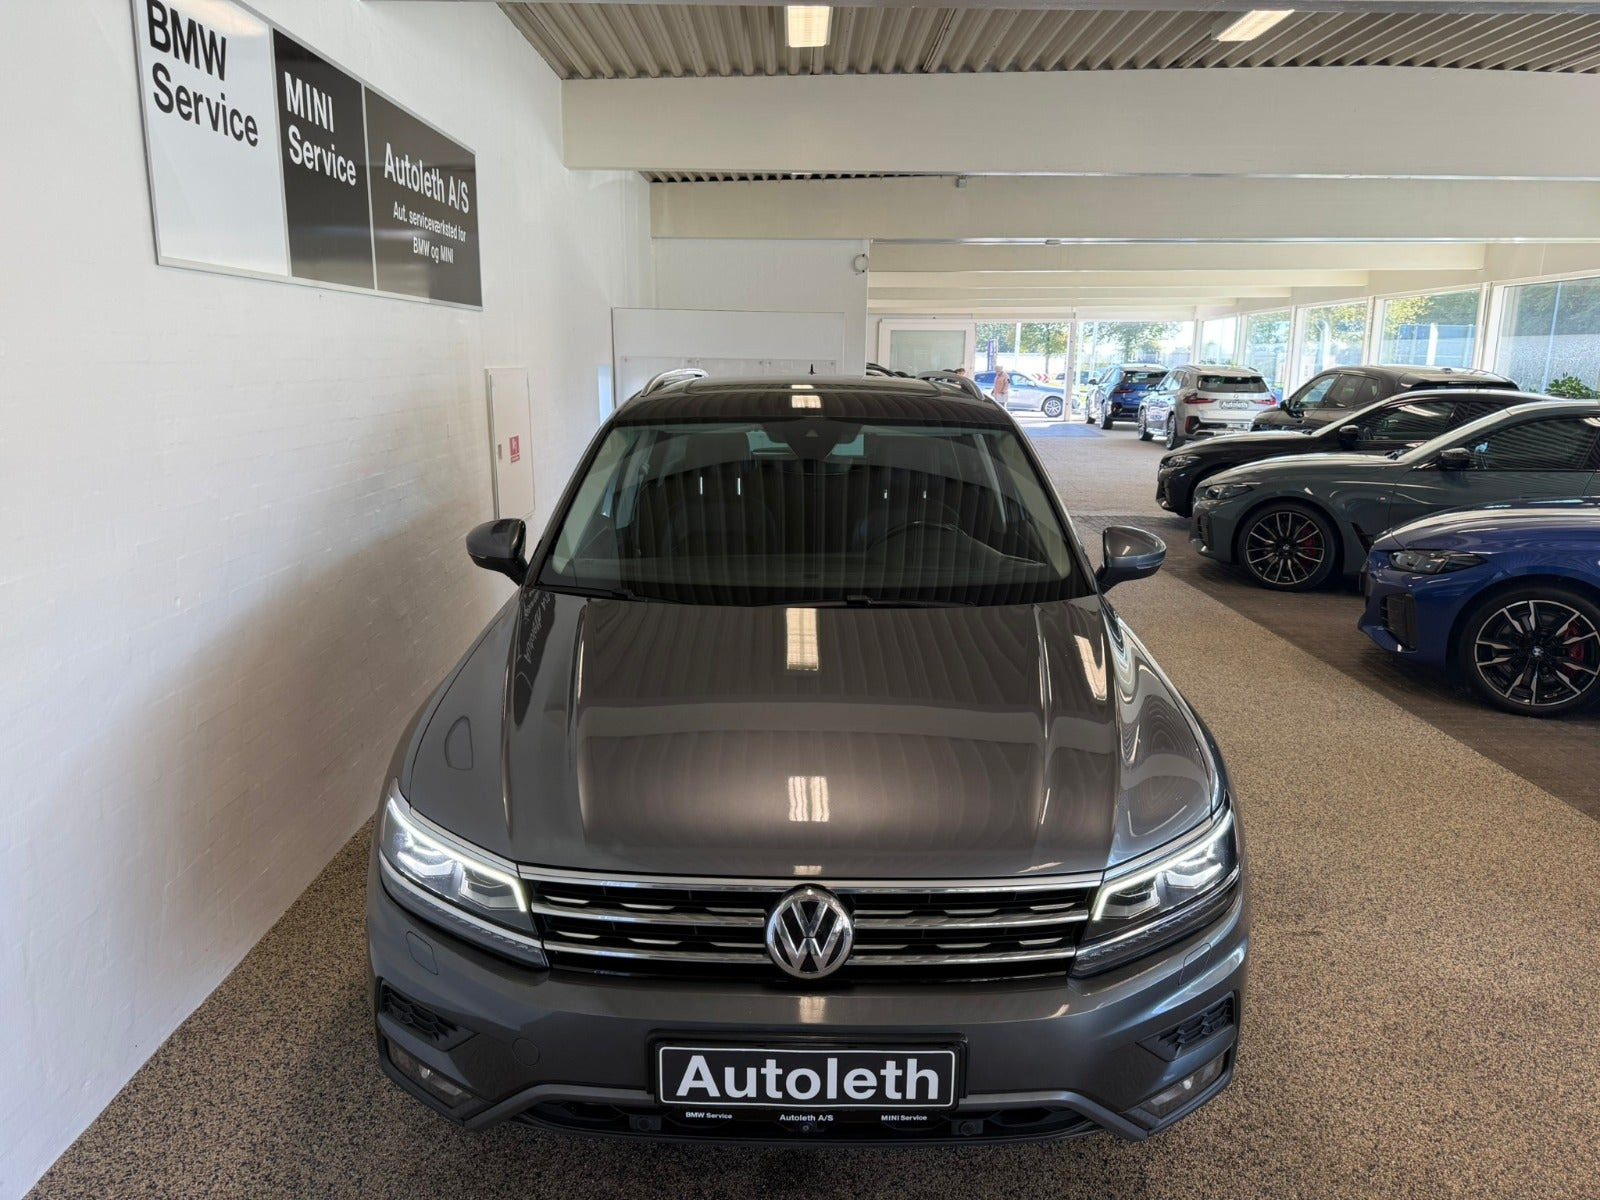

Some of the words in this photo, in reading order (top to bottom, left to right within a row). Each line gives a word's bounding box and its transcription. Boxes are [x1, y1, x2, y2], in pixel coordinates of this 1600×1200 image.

[147, 0, 227, 81] BMW
[152, 62, 258, 147] Service
[285, 71, 334, 133] MINI
[288, 124, 356, 186] Service
[384, 142, 445, 203] Autoleth
[448, 175, 469, 213] A/S
[393, 201, 407, 222] Aut.
[409, 212, 457, 240] serviceværksted
[413, 236, 430, 256] BMW
[431, 246, 439, 264] og
[440, 245, 454, 264] MINI
[676, 1055, 939, 1100] Autoleth
[685, 1111, 704, 1119] BMW
[706, 1112, 733, 1120] Service
[779, 1113, 816, 1122] Autoleth
[817, 1113, 834, 1122] A/S
[900, 1113, 928, 1121] Service
